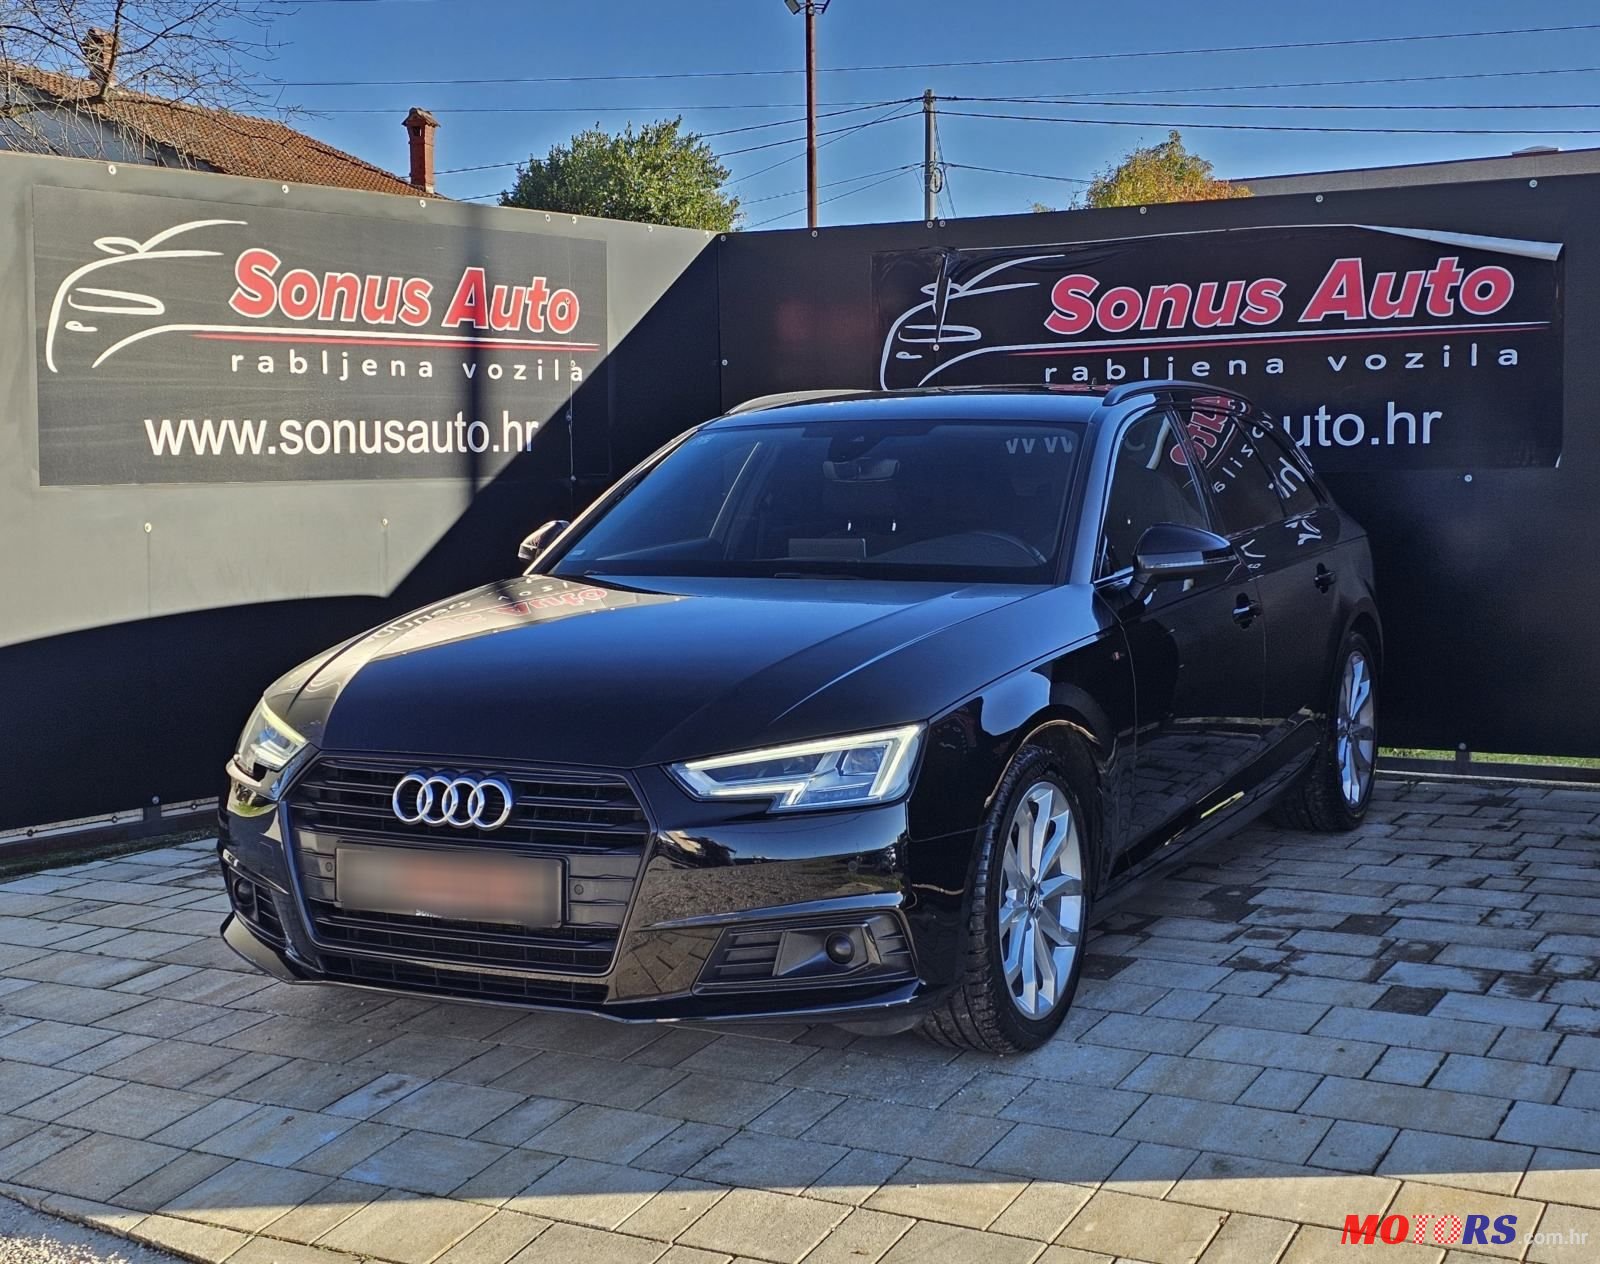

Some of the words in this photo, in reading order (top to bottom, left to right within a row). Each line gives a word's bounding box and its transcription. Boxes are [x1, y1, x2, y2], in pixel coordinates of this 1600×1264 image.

[229, 247, 434, 327] Sonus
[441, 266, 581, 334] Auto
[1043, 273, 1287, 335] Sonus
[1298, 256, 1516, 323] Auto
[230, 348, 434, 382] rabljena
[461, 358, 584, 382] vozila
[1044, 355, 1285, 382] rabljena
[1327, 342, 1520, 373] vozila
[143, 410, 540, 456] www.sonusauto.hr
